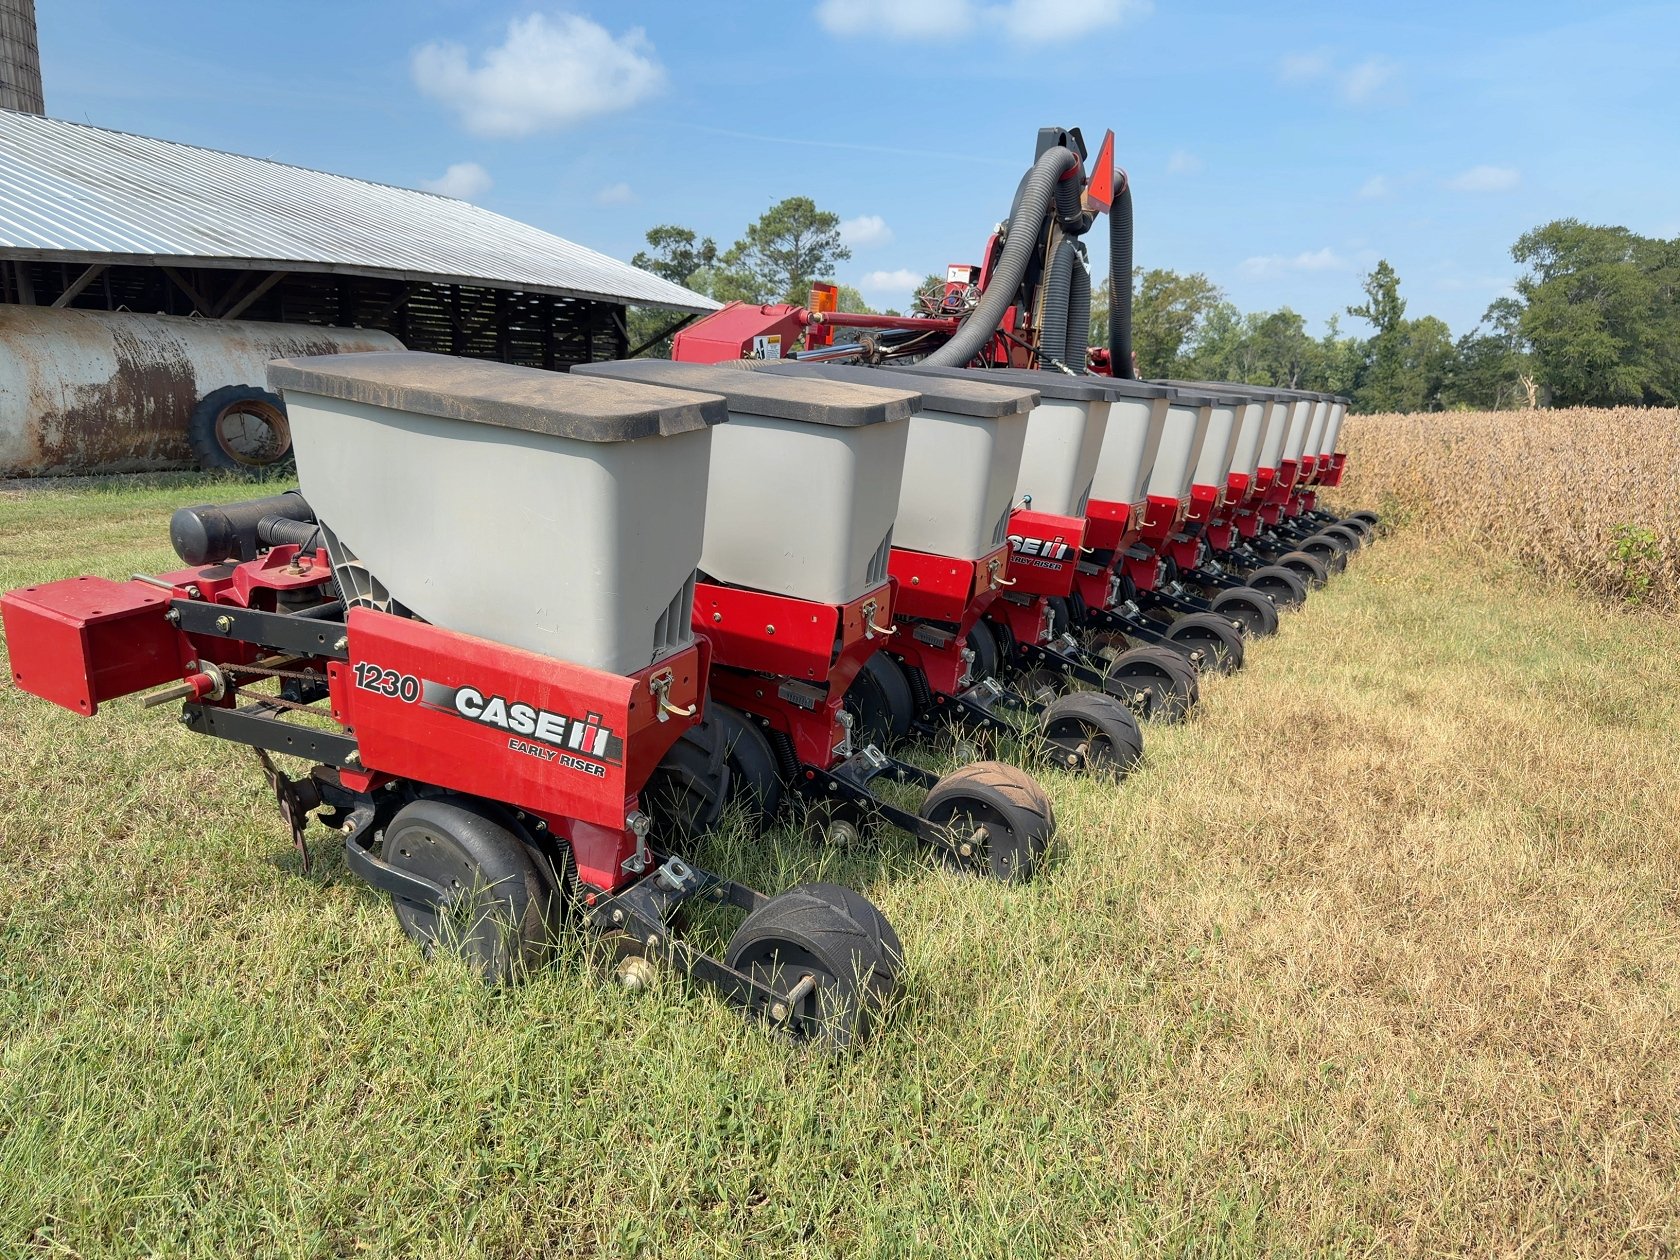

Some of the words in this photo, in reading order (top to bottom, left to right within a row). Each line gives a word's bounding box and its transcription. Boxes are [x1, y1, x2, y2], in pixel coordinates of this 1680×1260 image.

[1007, 535, 1042, 555] SE
[1033, 560, 1062, 571] RISER
[353, 662, 419, 703] 1230
[455, 688, 567, 744] CASE
[508, 738, 556, 761] EARLY
[559, 755, 605, 778] RISER
